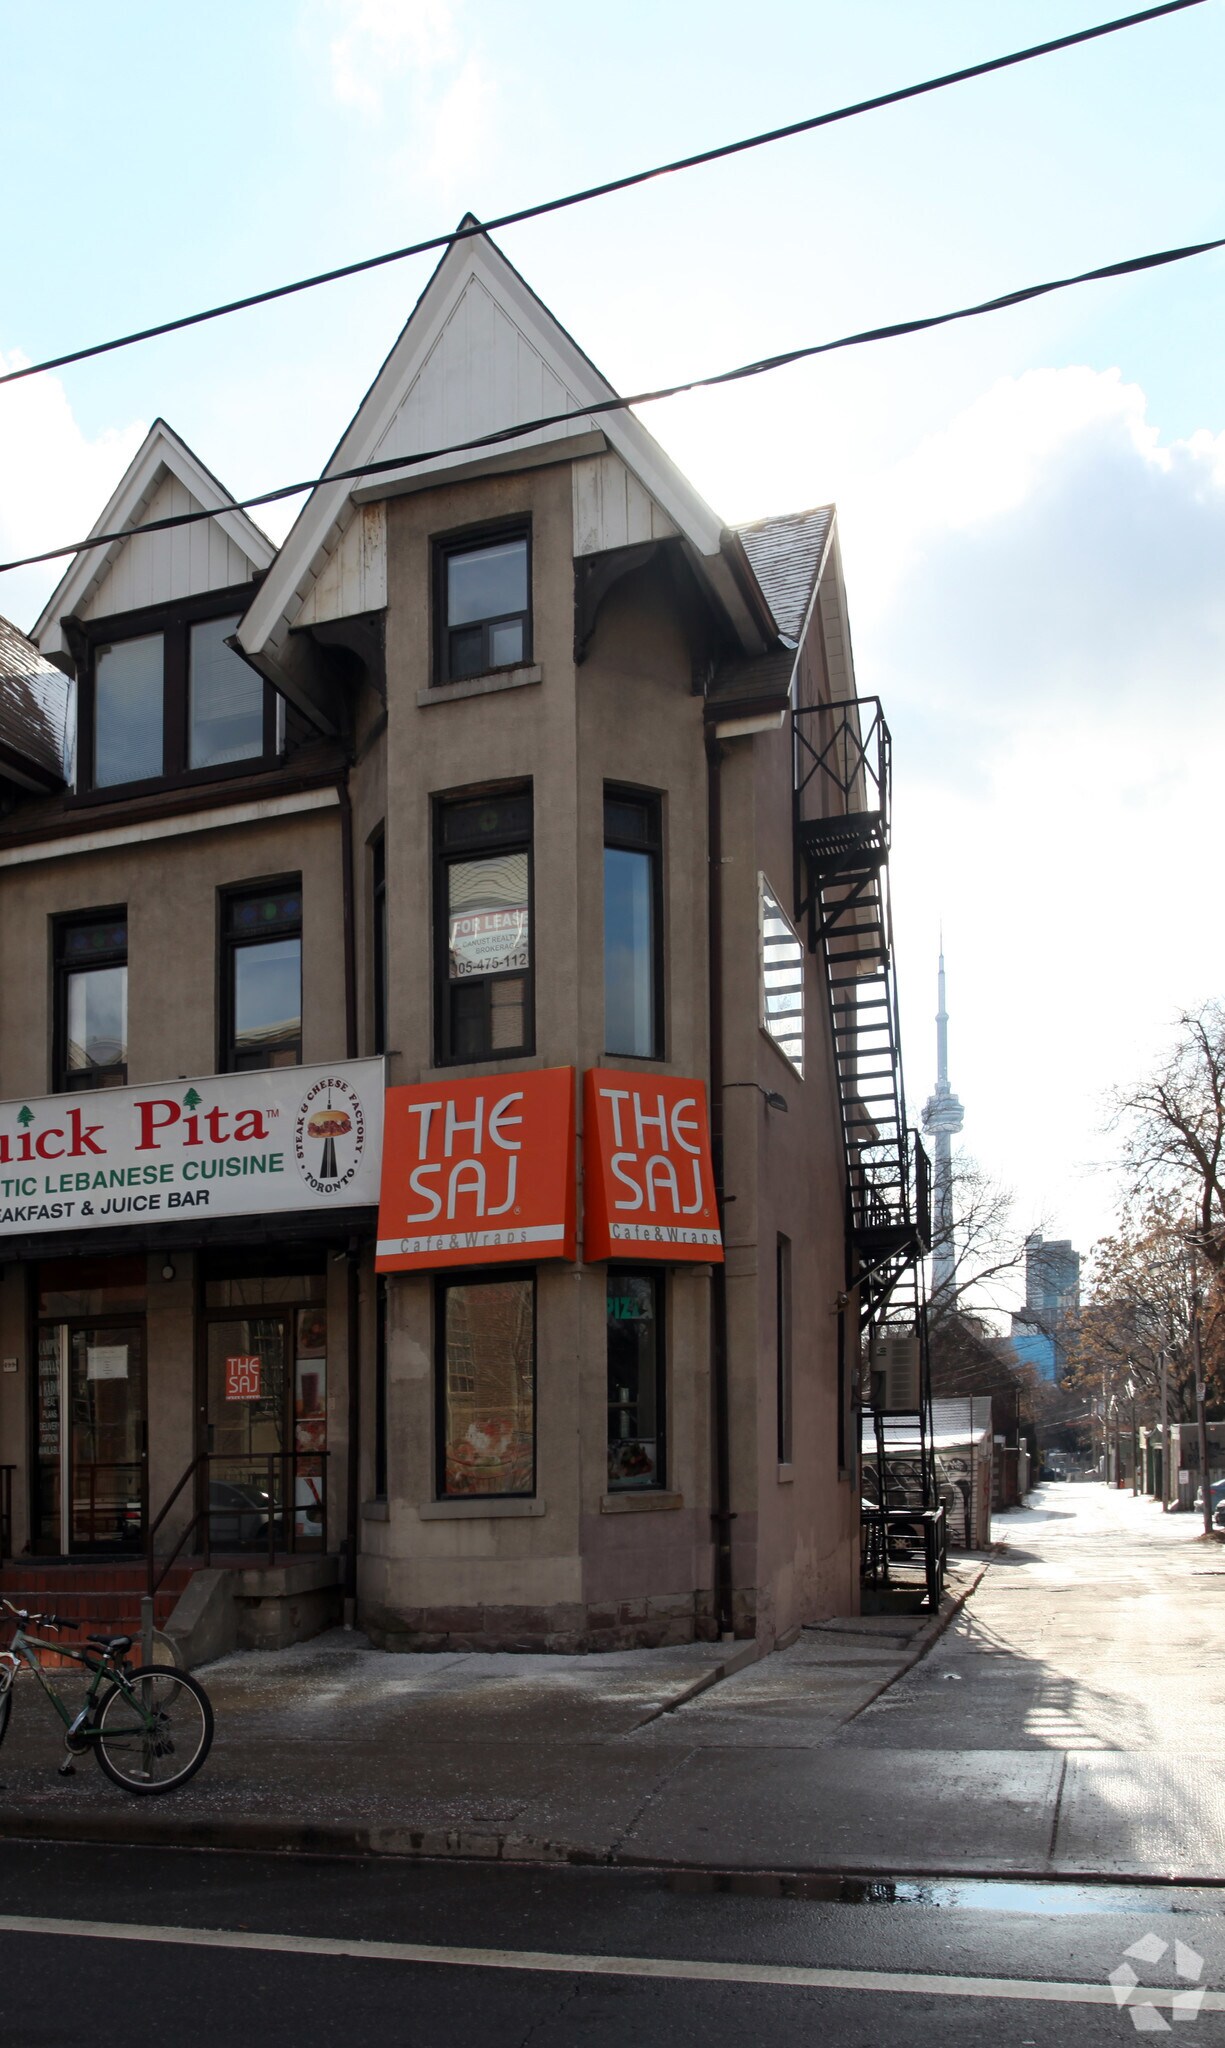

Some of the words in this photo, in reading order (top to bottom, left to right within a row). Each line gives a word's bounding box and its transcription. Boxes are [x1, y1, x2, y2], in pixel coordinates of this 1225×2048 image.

[455, 918, 480, 934] FOR
[476, 943, 519, 954] BROKERAGE
[133, 1099, 270, 1150] Pita
[296, 1117, 305, 1159] STEAK
[301, 1103, 308, 1113] &
[307, 1079, 349, 1101] CHEESE
[348, 1093, 365, 1154] FACTORY
[408, 1091, 524, 1161] THE
[599, 1088, 701, 1155] THE
[1, 1177, 37, 1198] TIC
[45, 1165, 174, 1194] LEBANESE
[182, 1152, 284, 1181] CUISINE
[304, 1168, 355, 1193] TORONTO
[407, 1155, 518, 1223] SAJ
[610, 1152, 703, 1215] SAJ
[0, 1202, 75, 1223] AKFAST
[81, 1200, 94, 1216] &
[101, 1194, 161, 1215] JUICE
[168, 1189, 210, 1208] BAR
[228, 1357, 259, 1376] THE
[229, 1375, 258, 1394] SAJ
